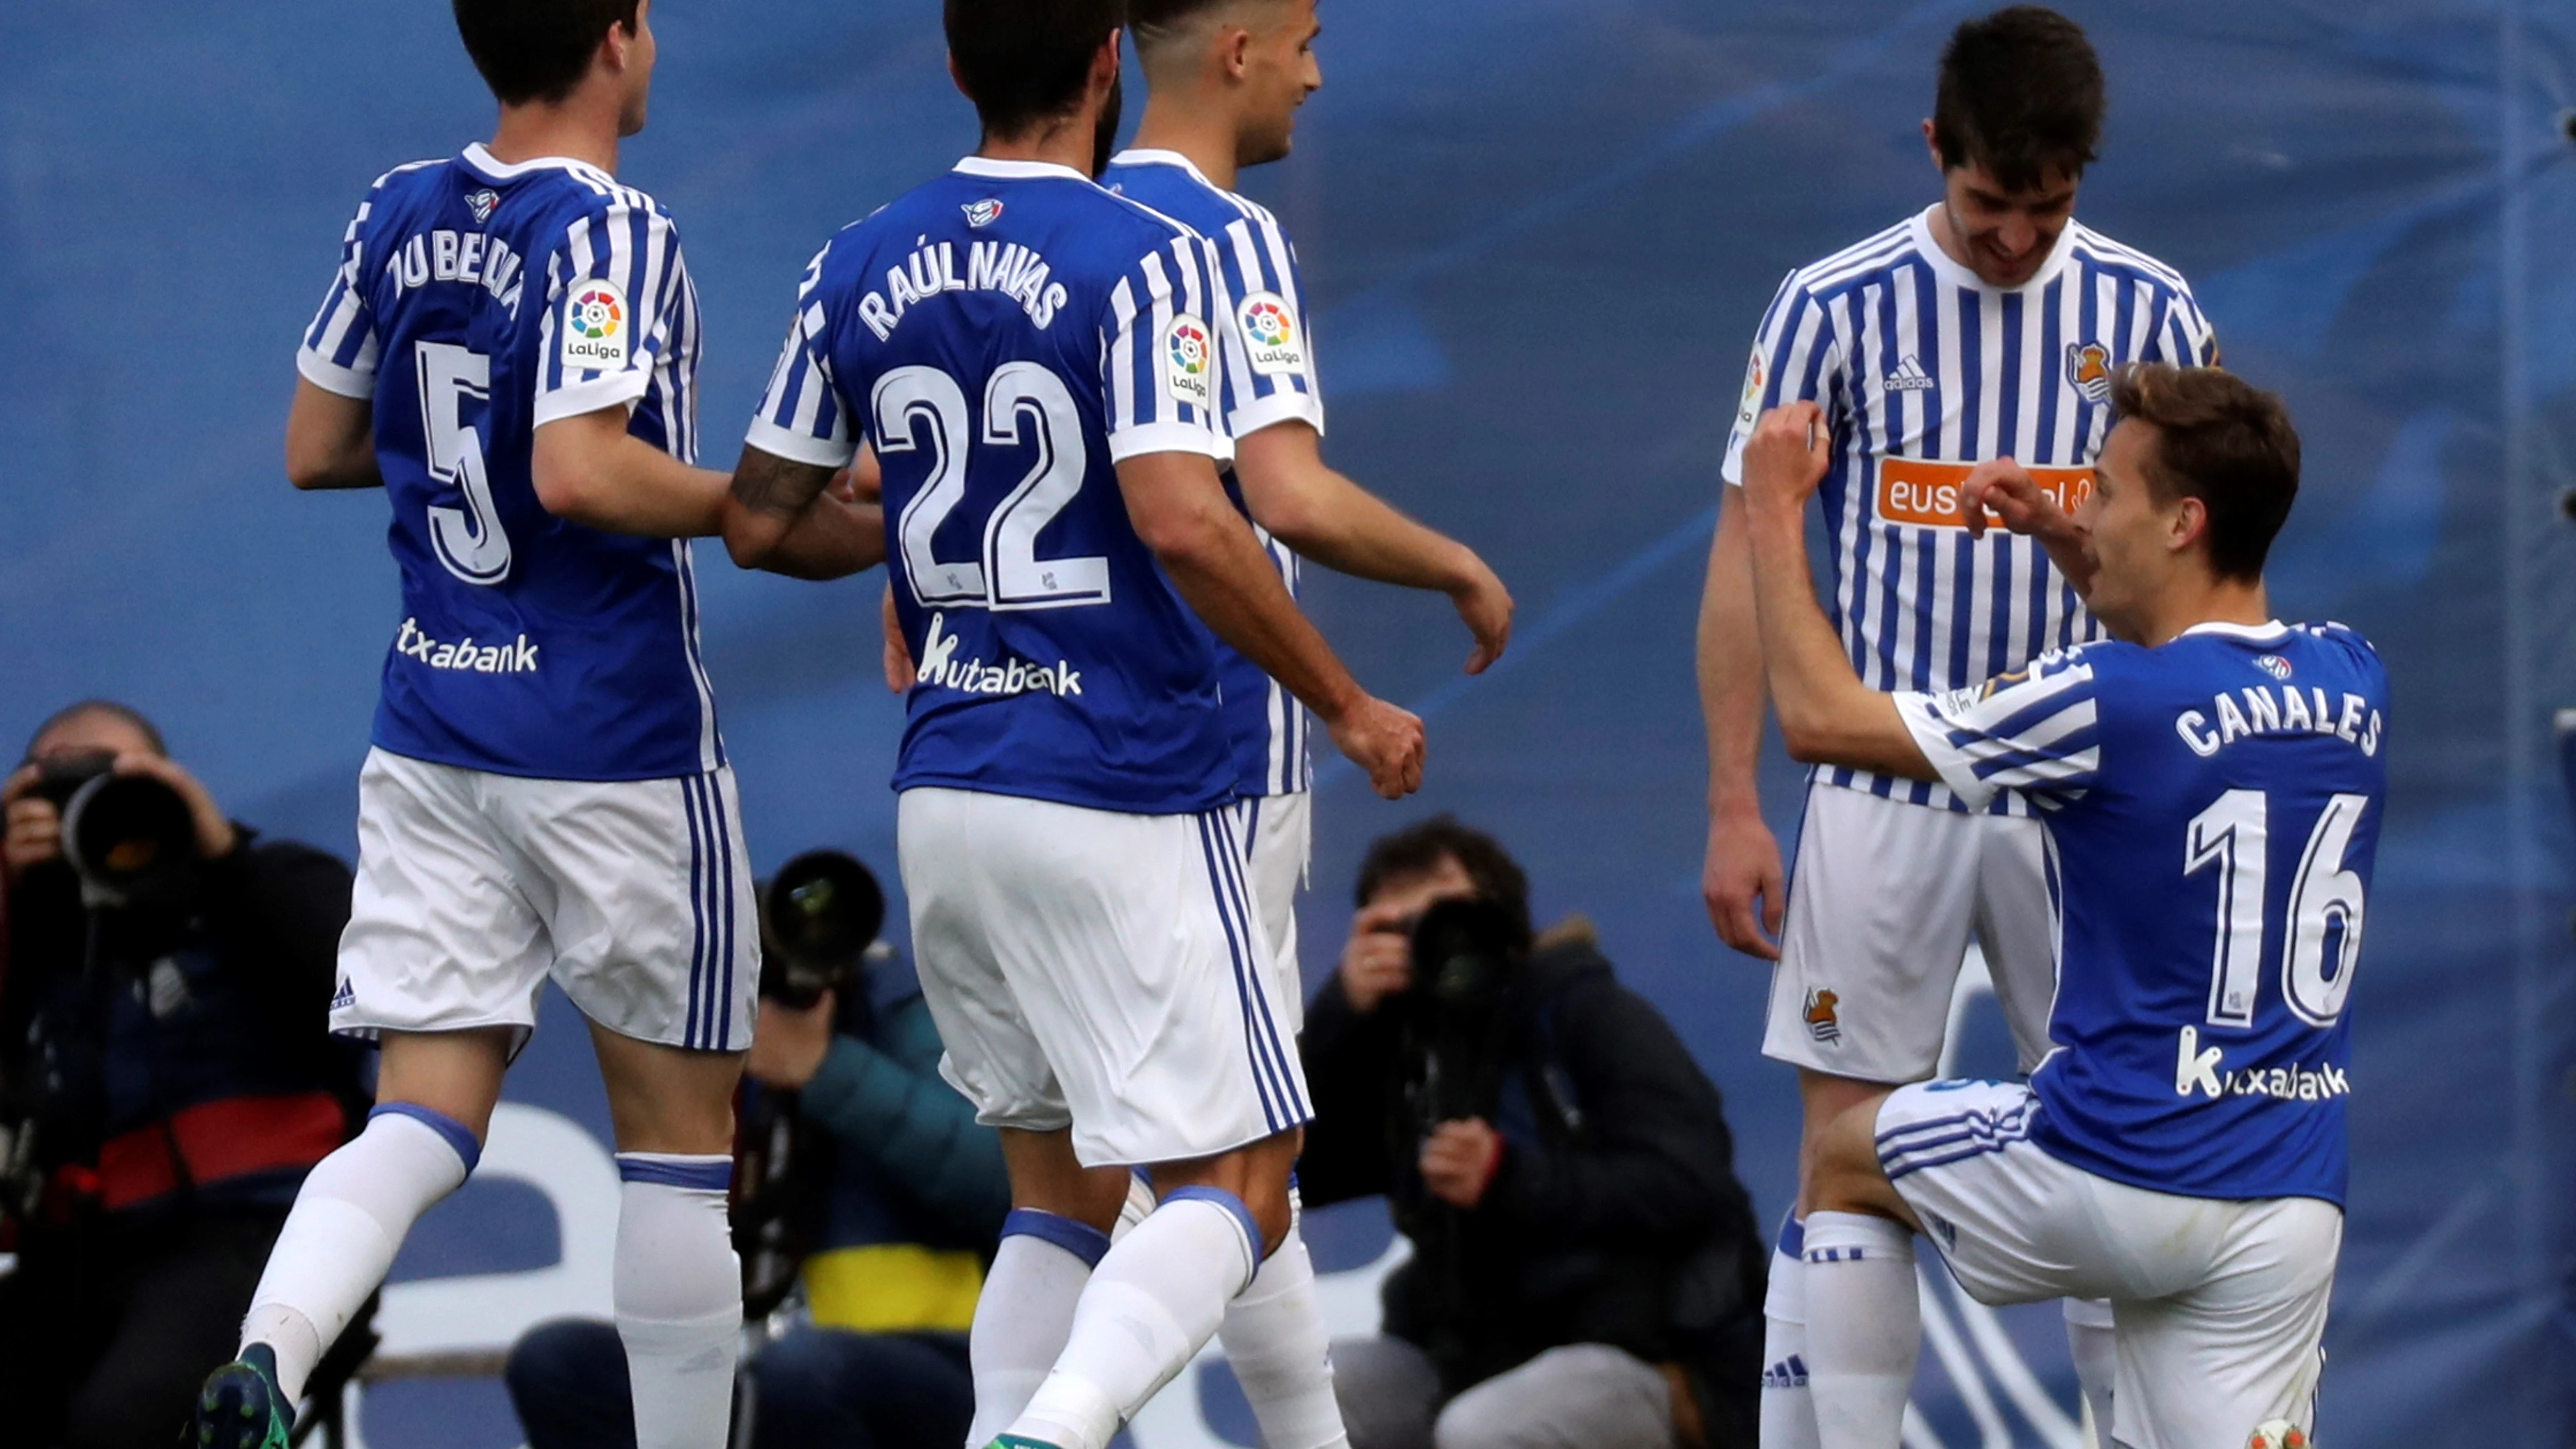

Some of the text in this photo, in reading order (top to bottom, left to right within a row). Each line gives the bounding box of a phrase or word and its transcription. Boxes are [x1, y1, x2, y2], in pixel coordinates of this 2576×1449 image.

[858, 234, 1068, 343] RAÚL NAVAS
[568, 343, 620, 359] LaLiga
[1173, 375, 1206, 397] LaLiga
[1255, 348, 1301, 364] LaLiga
[1884, 377, 1934, 391] adidas
[415, 340, 512, 585] 5
[871, 361, 1111, 611] 22
[2176, 685, 2381, 757] CANALES
[2184, 789, 2369, 1028] 16
